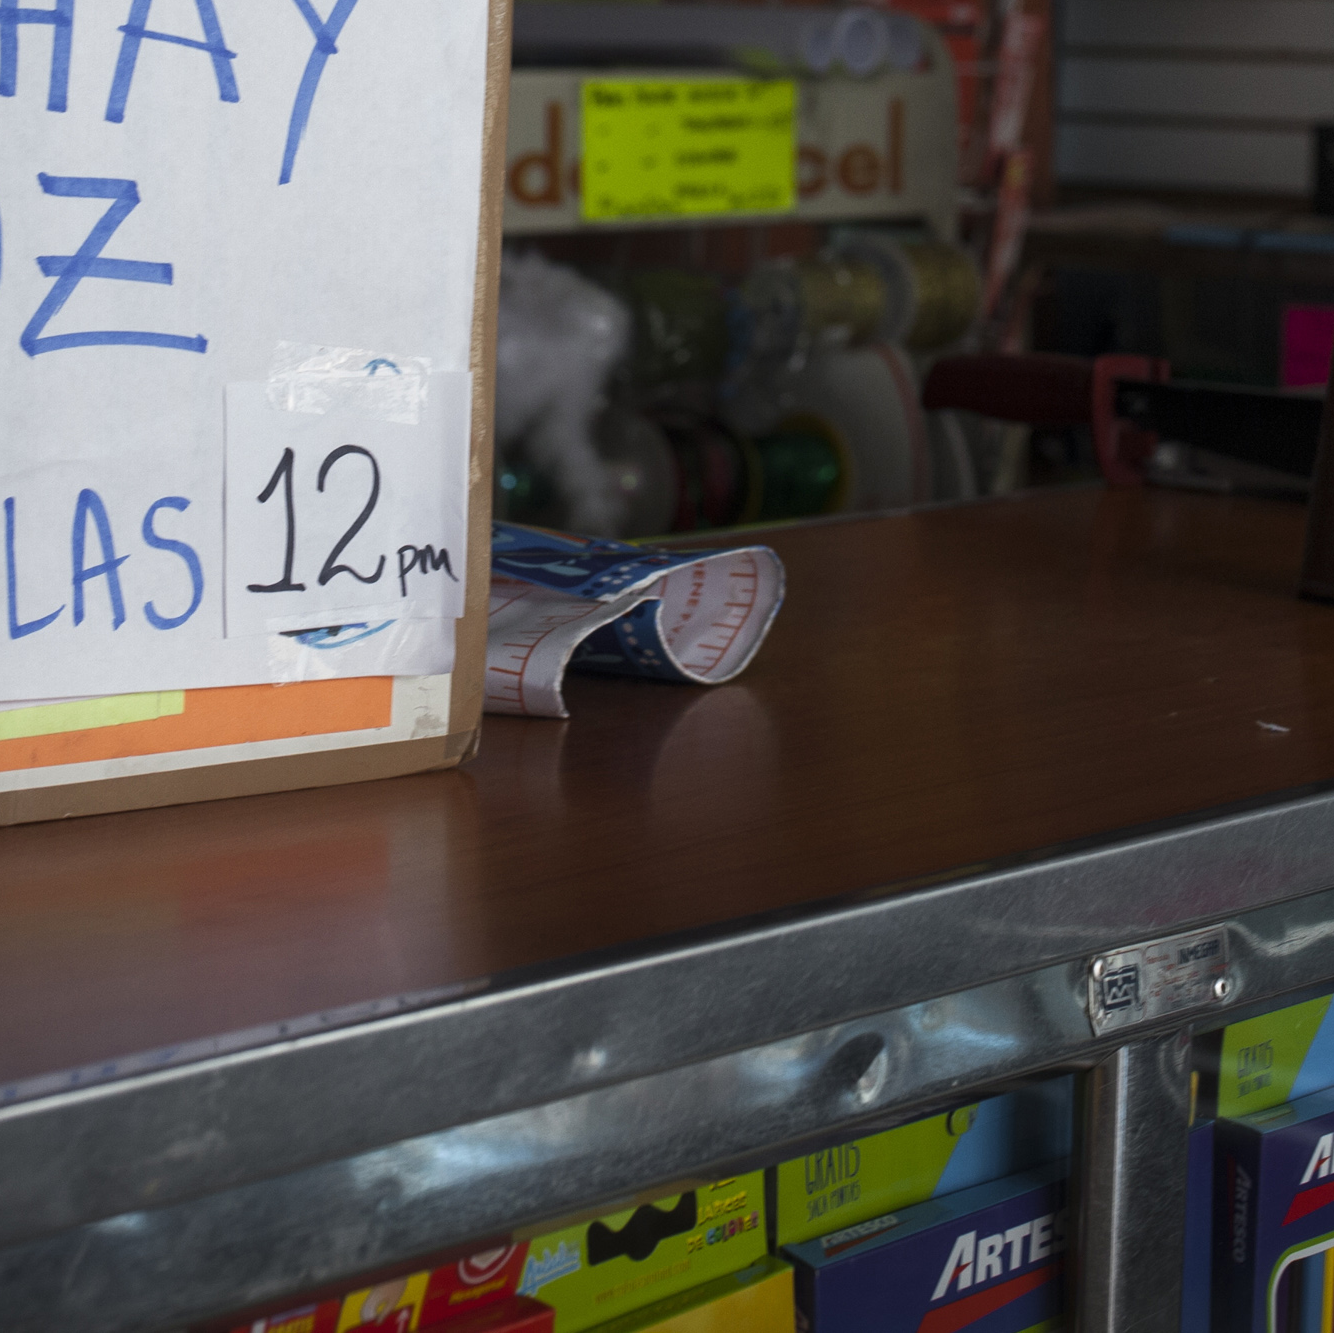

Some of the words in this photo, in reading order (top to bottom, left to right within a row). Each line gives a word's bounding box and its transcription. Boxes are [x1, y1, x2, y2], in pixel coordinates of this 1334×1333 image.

[4, 496, 206, 639] LAS
[247, 444, 386, 593] 12
[397, 544, 459, 597] pm
[1232, 1164, 1254, 1264] ARTESCO
